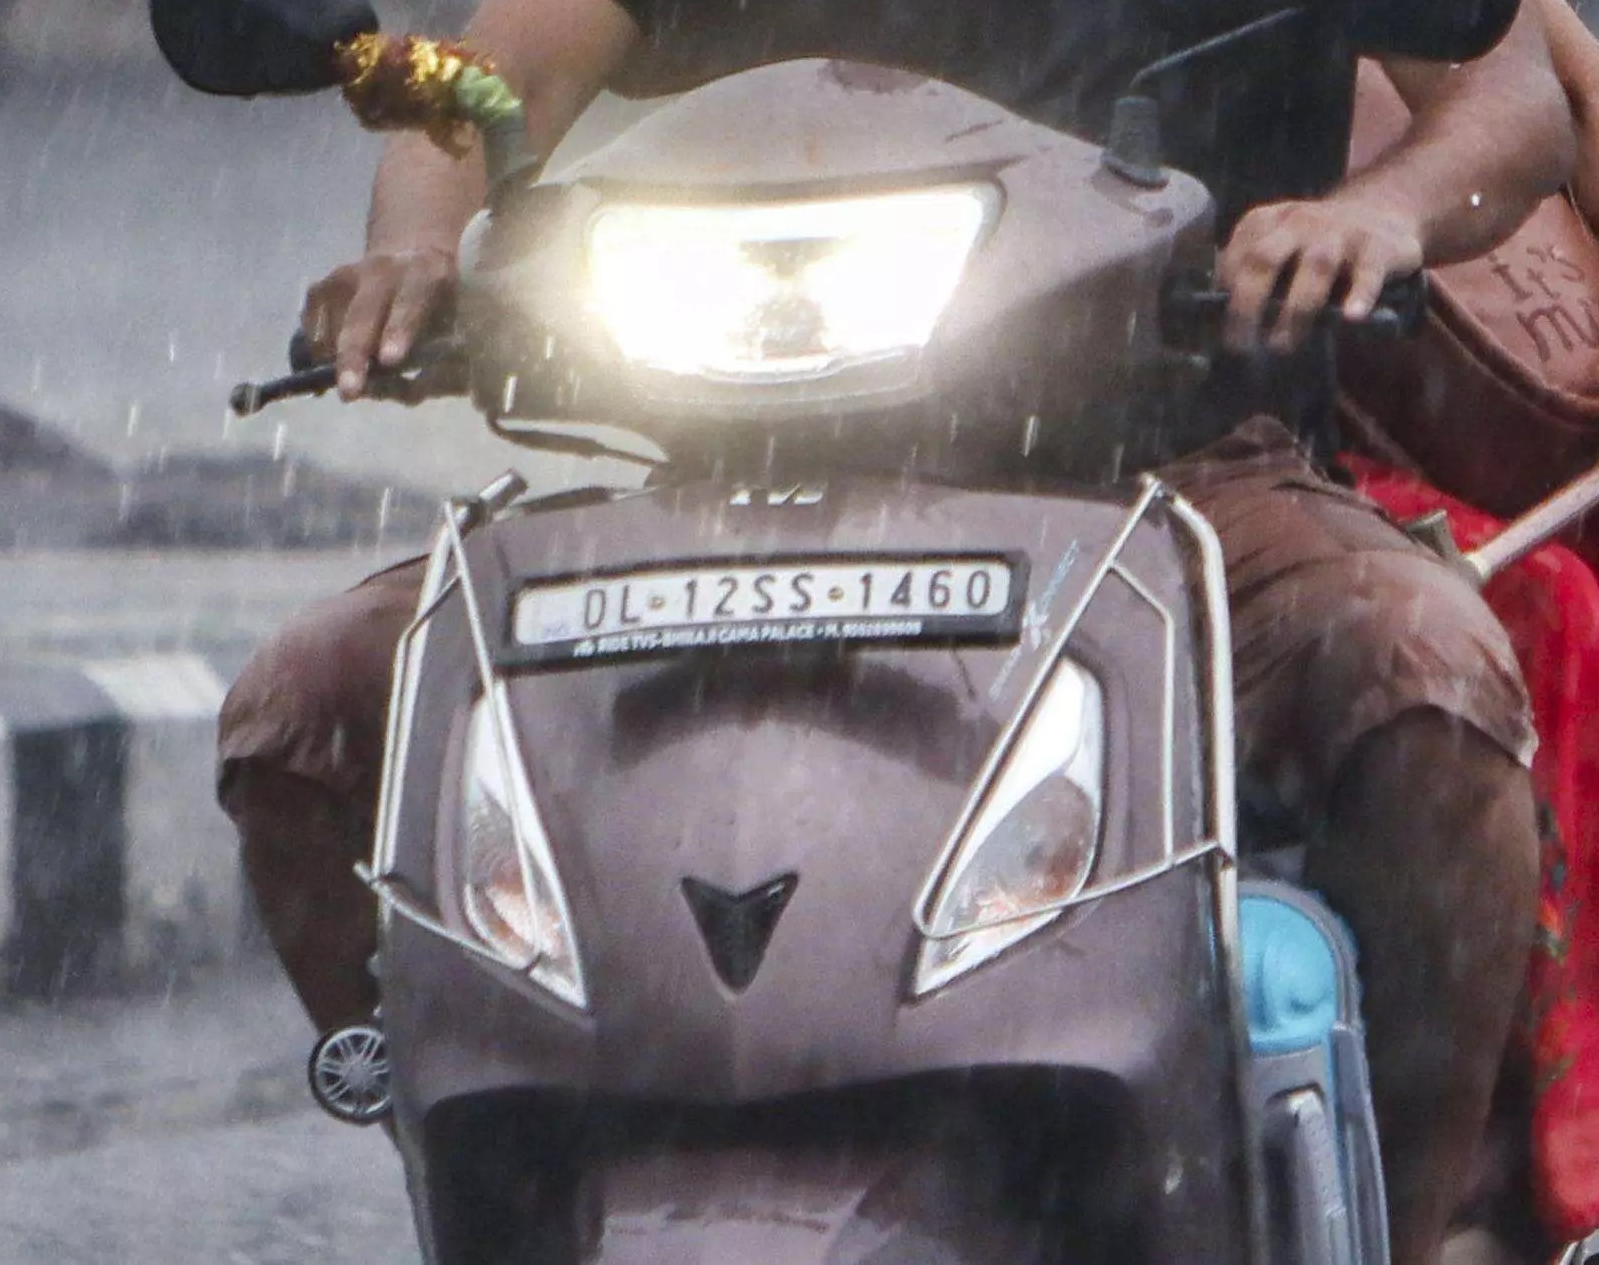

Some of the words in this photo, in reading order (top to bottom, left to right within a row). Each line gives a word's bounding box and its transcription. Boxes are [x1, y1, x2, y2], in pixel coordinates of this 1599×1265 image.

[583, 584, 641, 630] DL
[685, 572, 814, 619] 12SS
[857, 568, 991, 610] 1460
